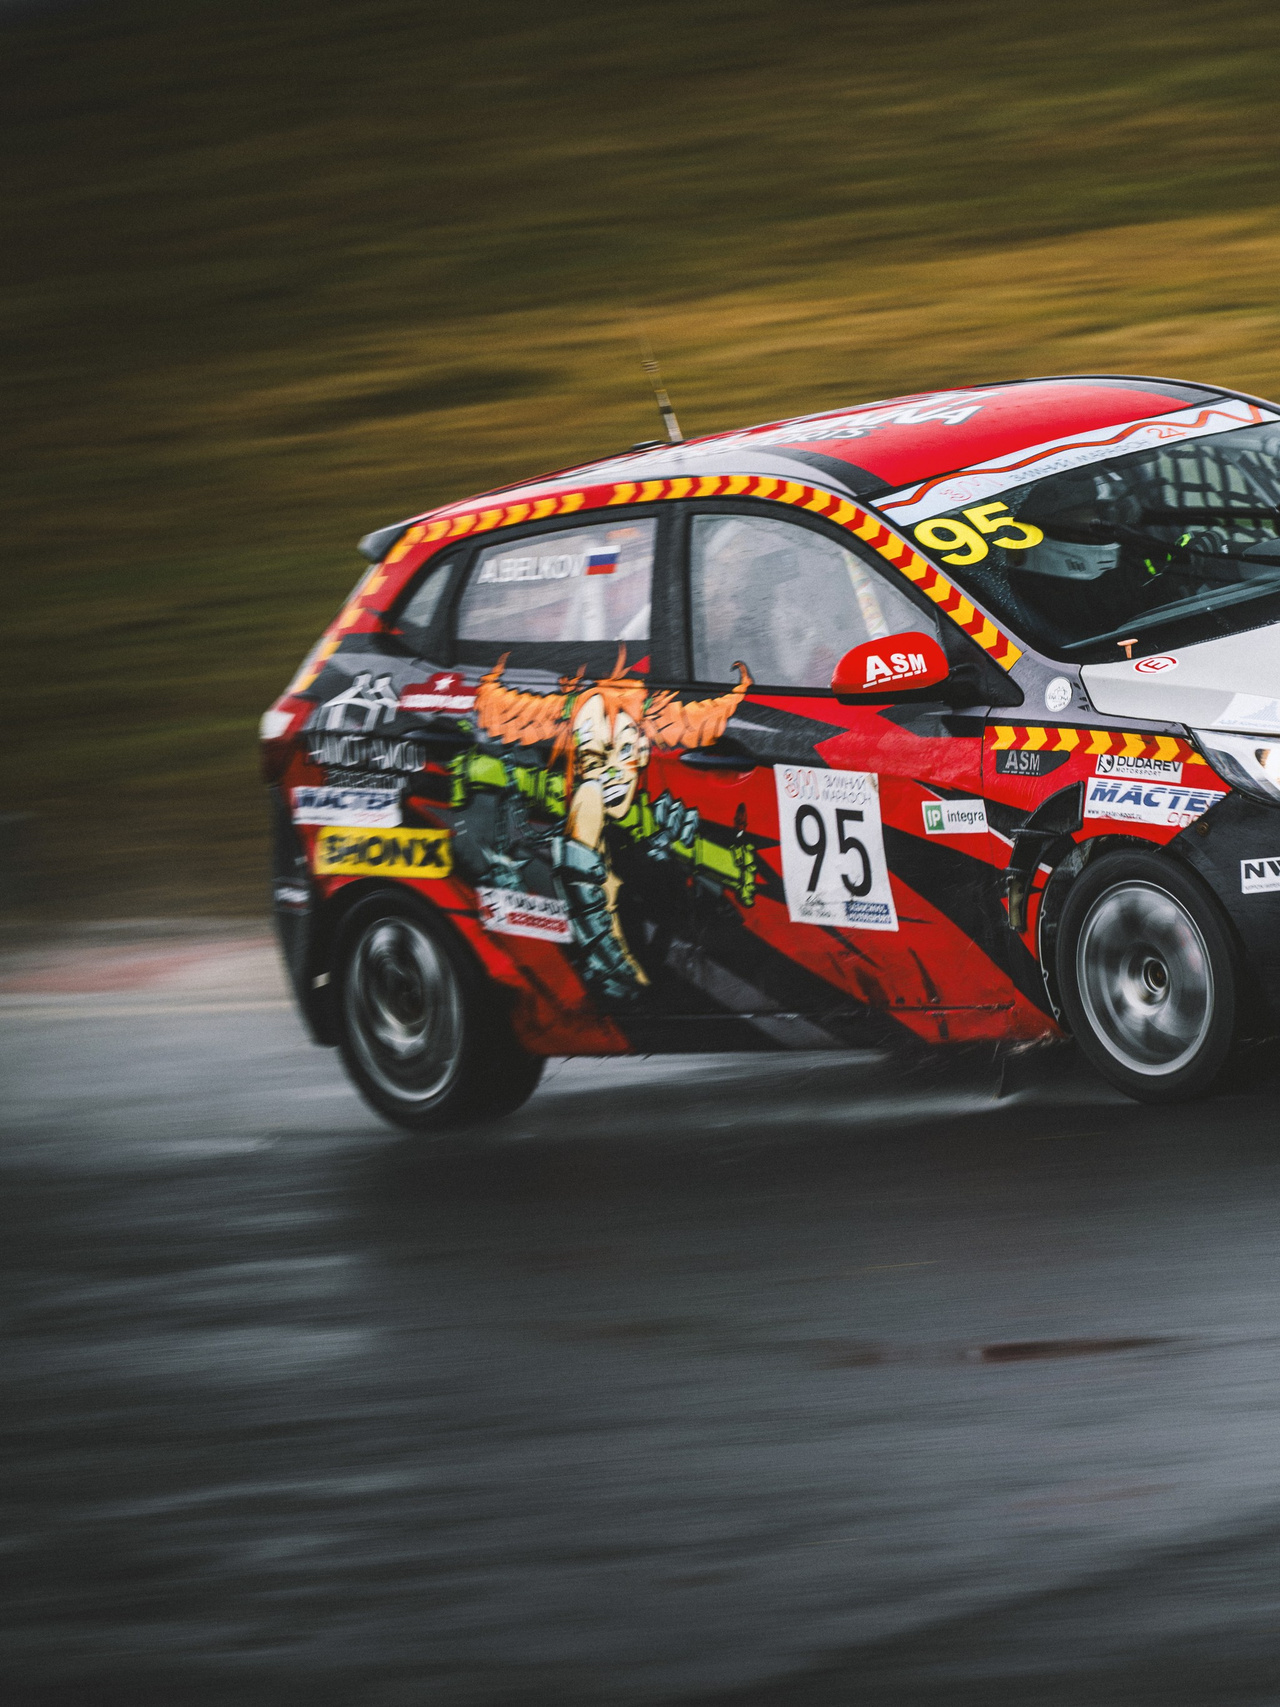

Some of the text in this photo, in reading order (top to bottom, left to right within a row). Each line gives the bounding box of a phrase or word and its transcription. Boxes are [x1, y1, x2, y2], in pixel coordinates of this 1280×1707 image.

[913, 501, 1044, 566] 95
[865, 652, 928, 683] ASM
[1004, 749, 1041, 771] ASM
[1117, 755, 1182, 773] DUDAREV
[1115, 766, 1162, 777] MOTORSPORT
[946, 809, 985, 826] integra
[795, 804, 872, 897] 95
